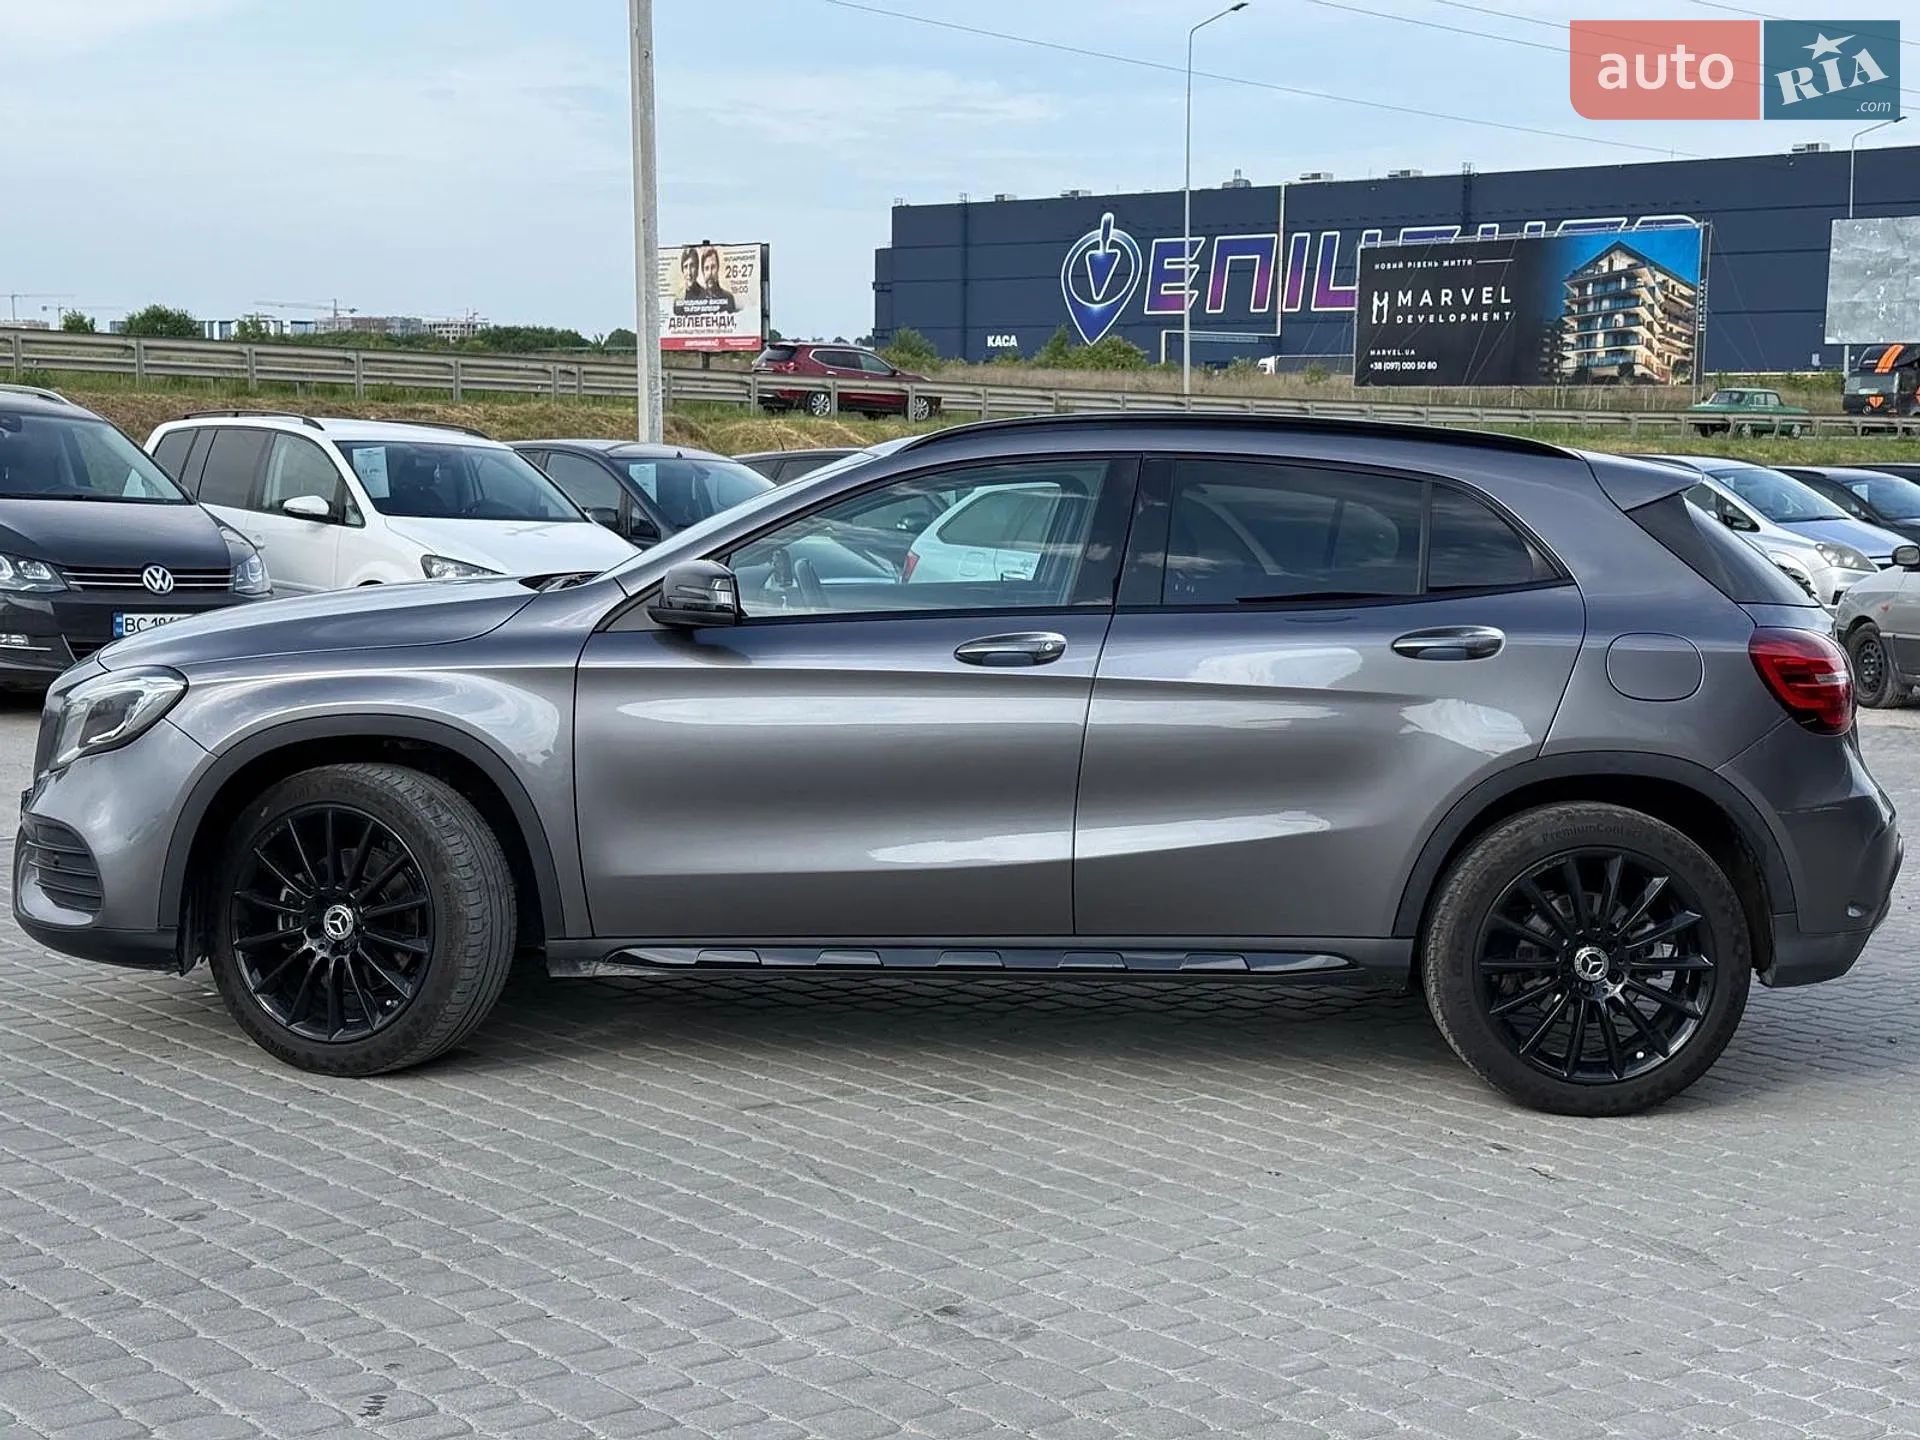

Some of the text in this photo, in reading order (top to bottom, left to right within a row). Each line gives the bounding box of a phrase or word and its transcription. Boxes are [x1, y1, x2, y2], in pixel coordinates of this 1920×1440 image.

[1407, 260, 1439, 269] РІВЕНЬ
[1397, 286, 1511, 307] MARVEL
[1396, 311, 1511, 324] DEVELOPMENT
[986, 334, 1018, 347] КАСА
